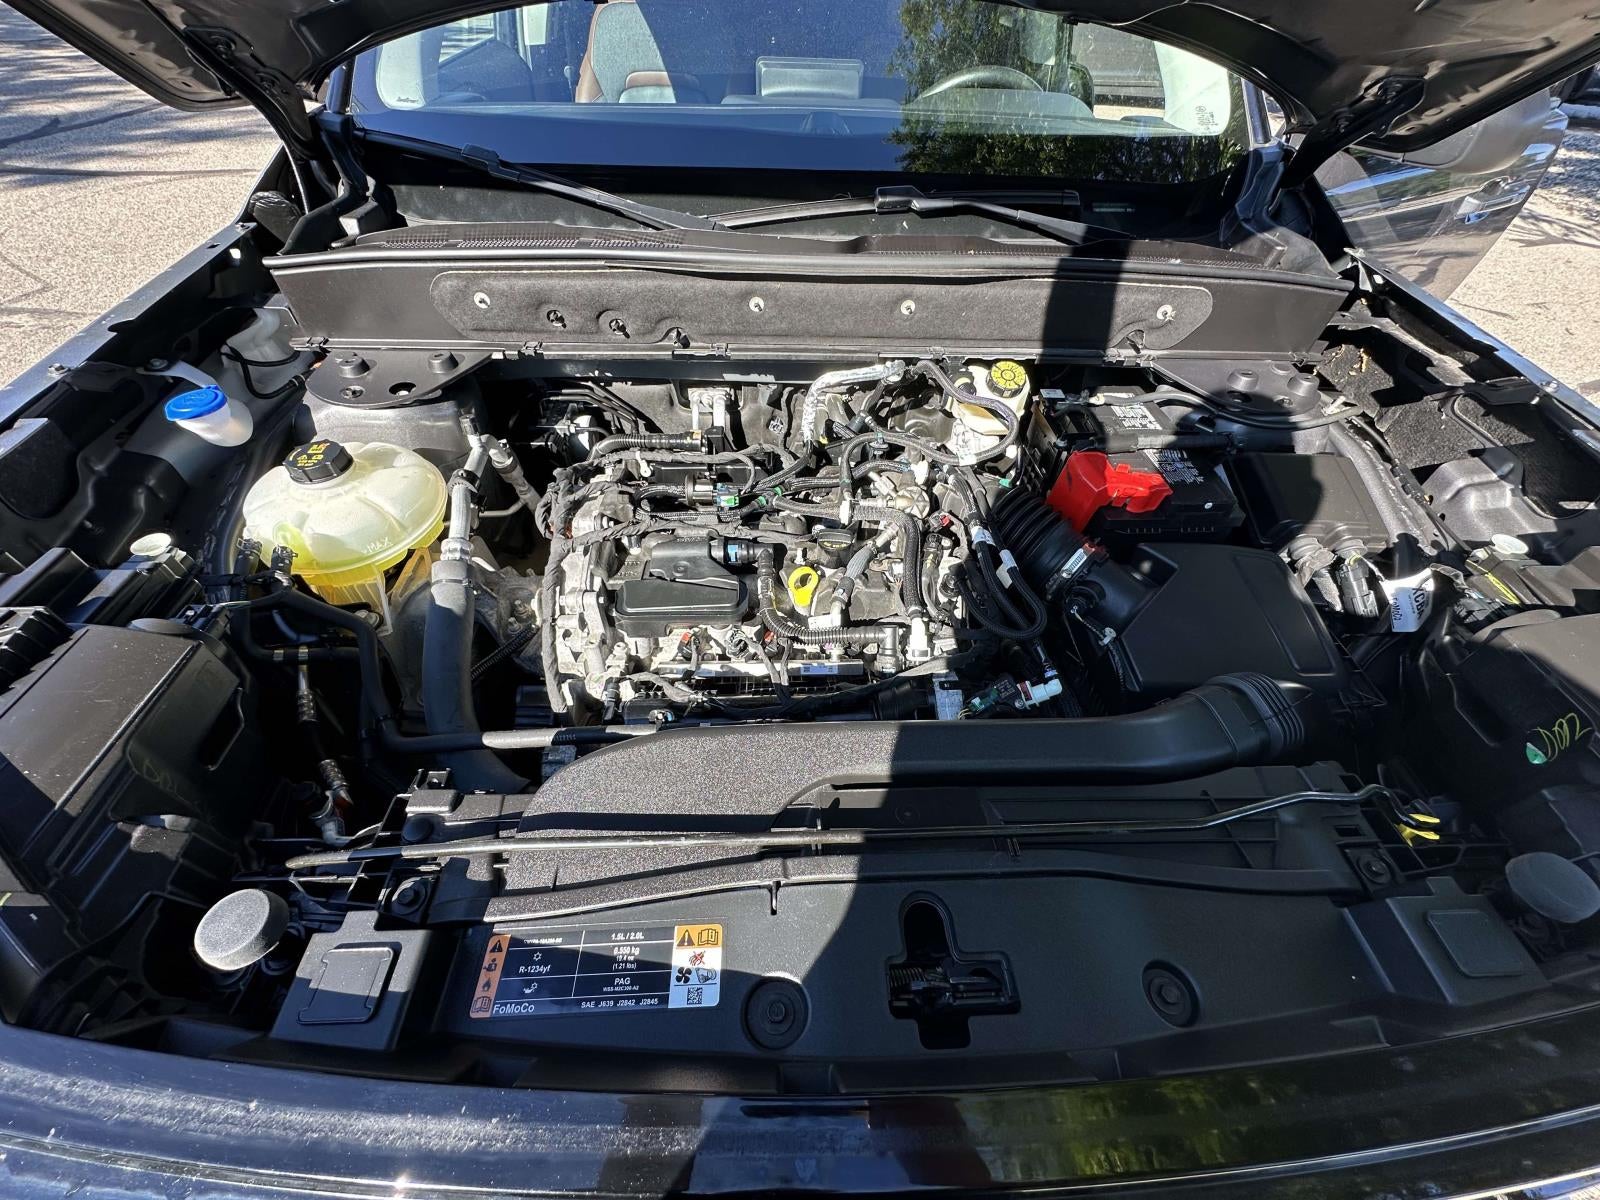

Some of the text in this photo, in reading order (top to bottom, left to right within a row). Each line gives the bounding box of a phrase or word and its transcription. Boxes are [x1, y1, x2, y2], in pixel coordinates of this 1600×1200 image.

[518, 964, 552, 974] R-1234yf
[614, 977, 631, 985] PAG
[492, 1002, 535, 1015] FoMoCo
[581, 1001, 596, 1009] SAE
[597, 1000, 614, 1008] J639
